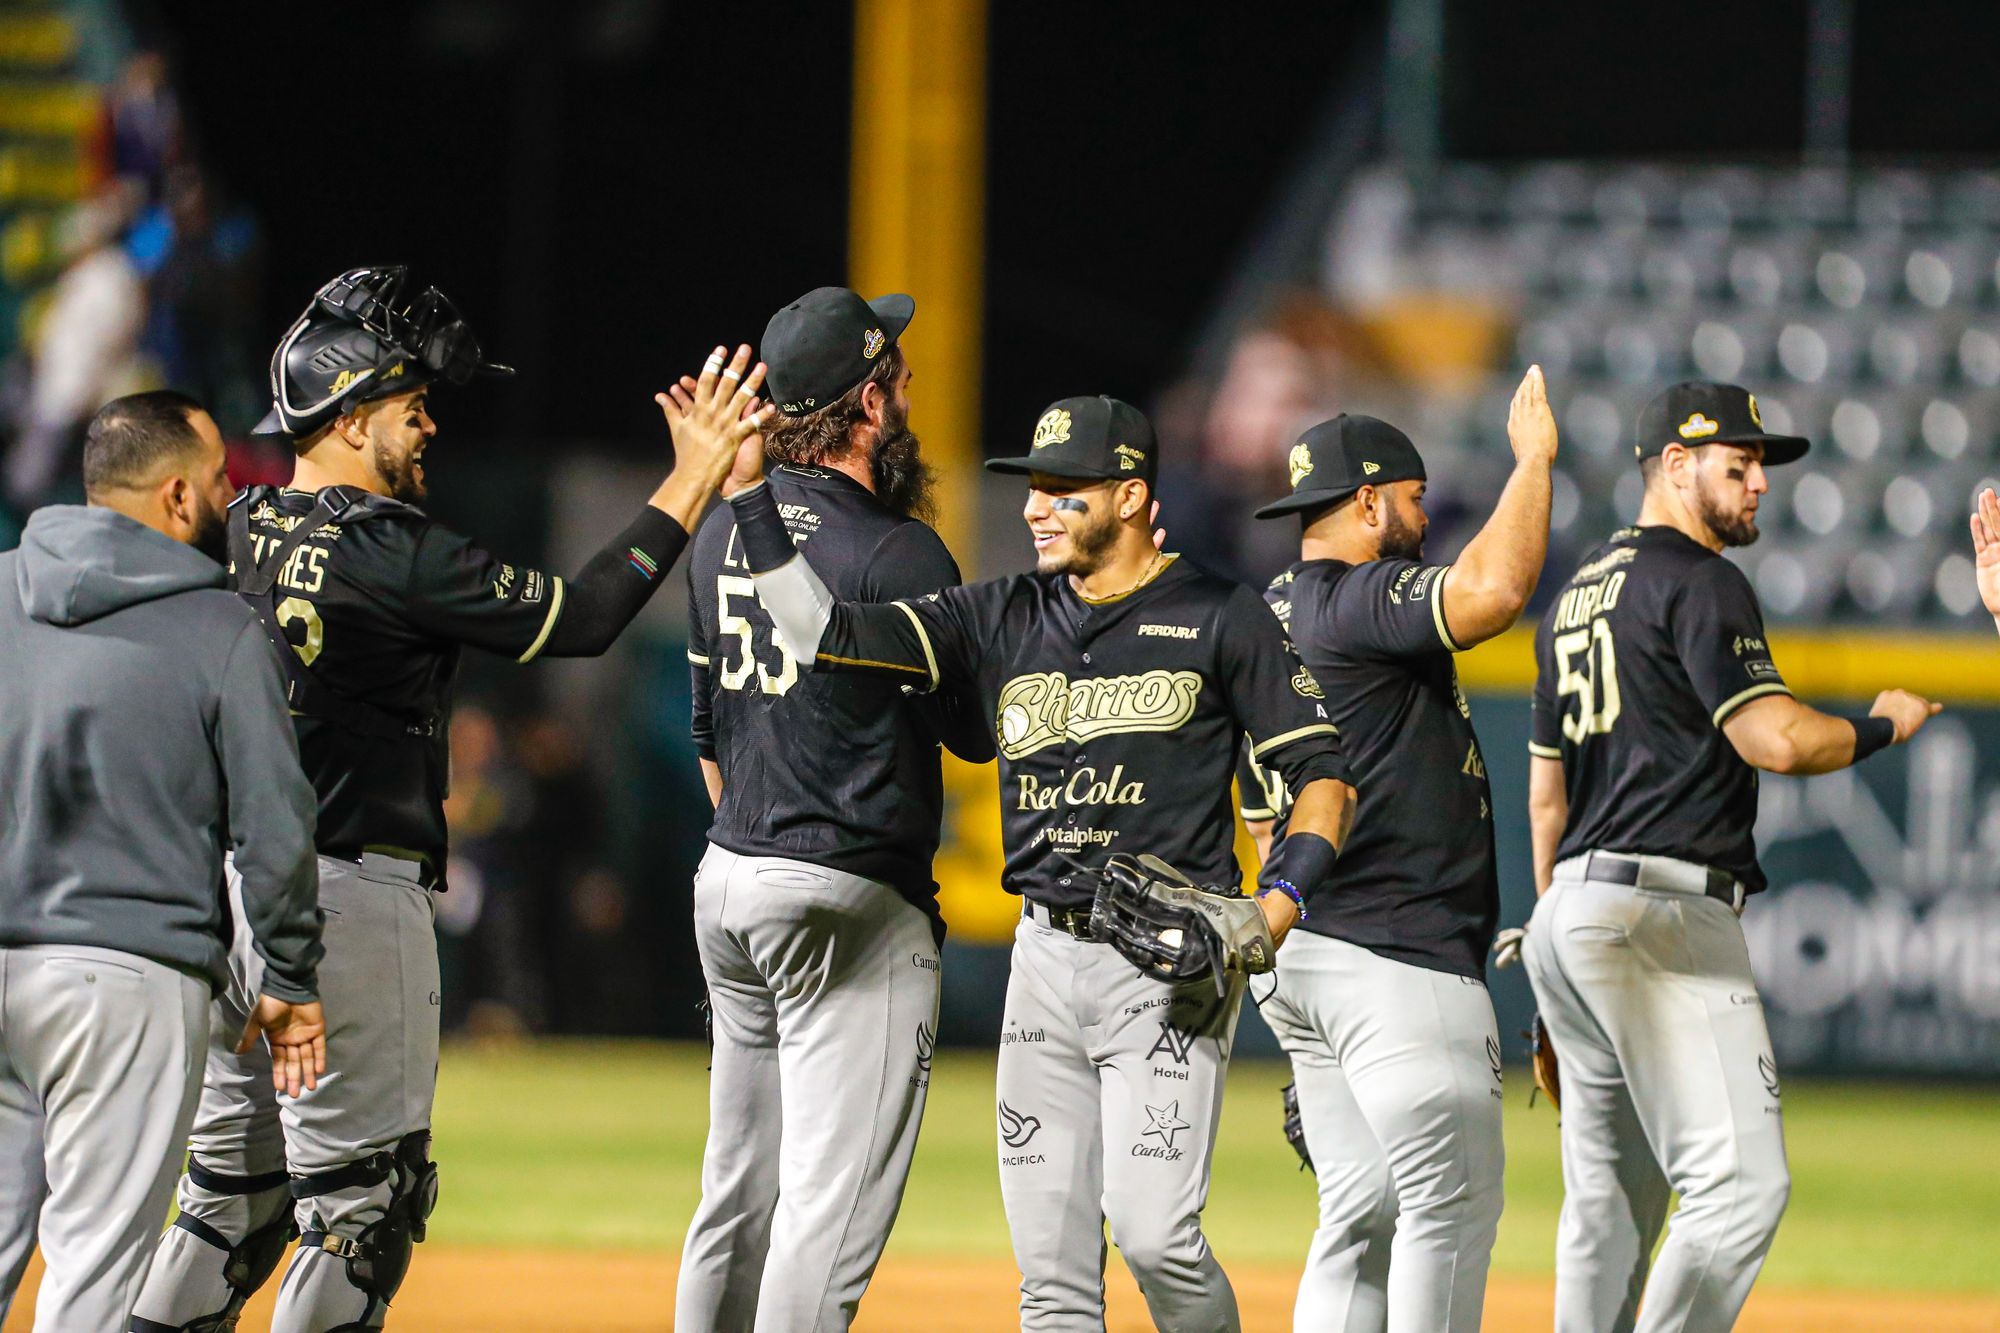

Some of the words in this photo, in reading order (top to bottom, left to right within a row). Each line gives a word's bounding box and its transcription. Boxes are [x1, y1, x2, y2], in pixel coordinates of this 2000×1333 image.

[717, 574, 798, 697] 53
[1137, 624, 1199, 640] PERDURA
[1554, 616, 1622, 746] 50
[997, 670, 1204, 762] Charros
[1064, 764, 1147, 806] Cola
[1018, 1028, 1046, 1043] Azul
[1153, 1066, 1189, 1081] Hotel
[1002, 1154, 1045, 1167] PACIFICA
[1131, 1143, 1167, 1159] Carl's
[1165, 1147, 1184, 1162] Jr.
